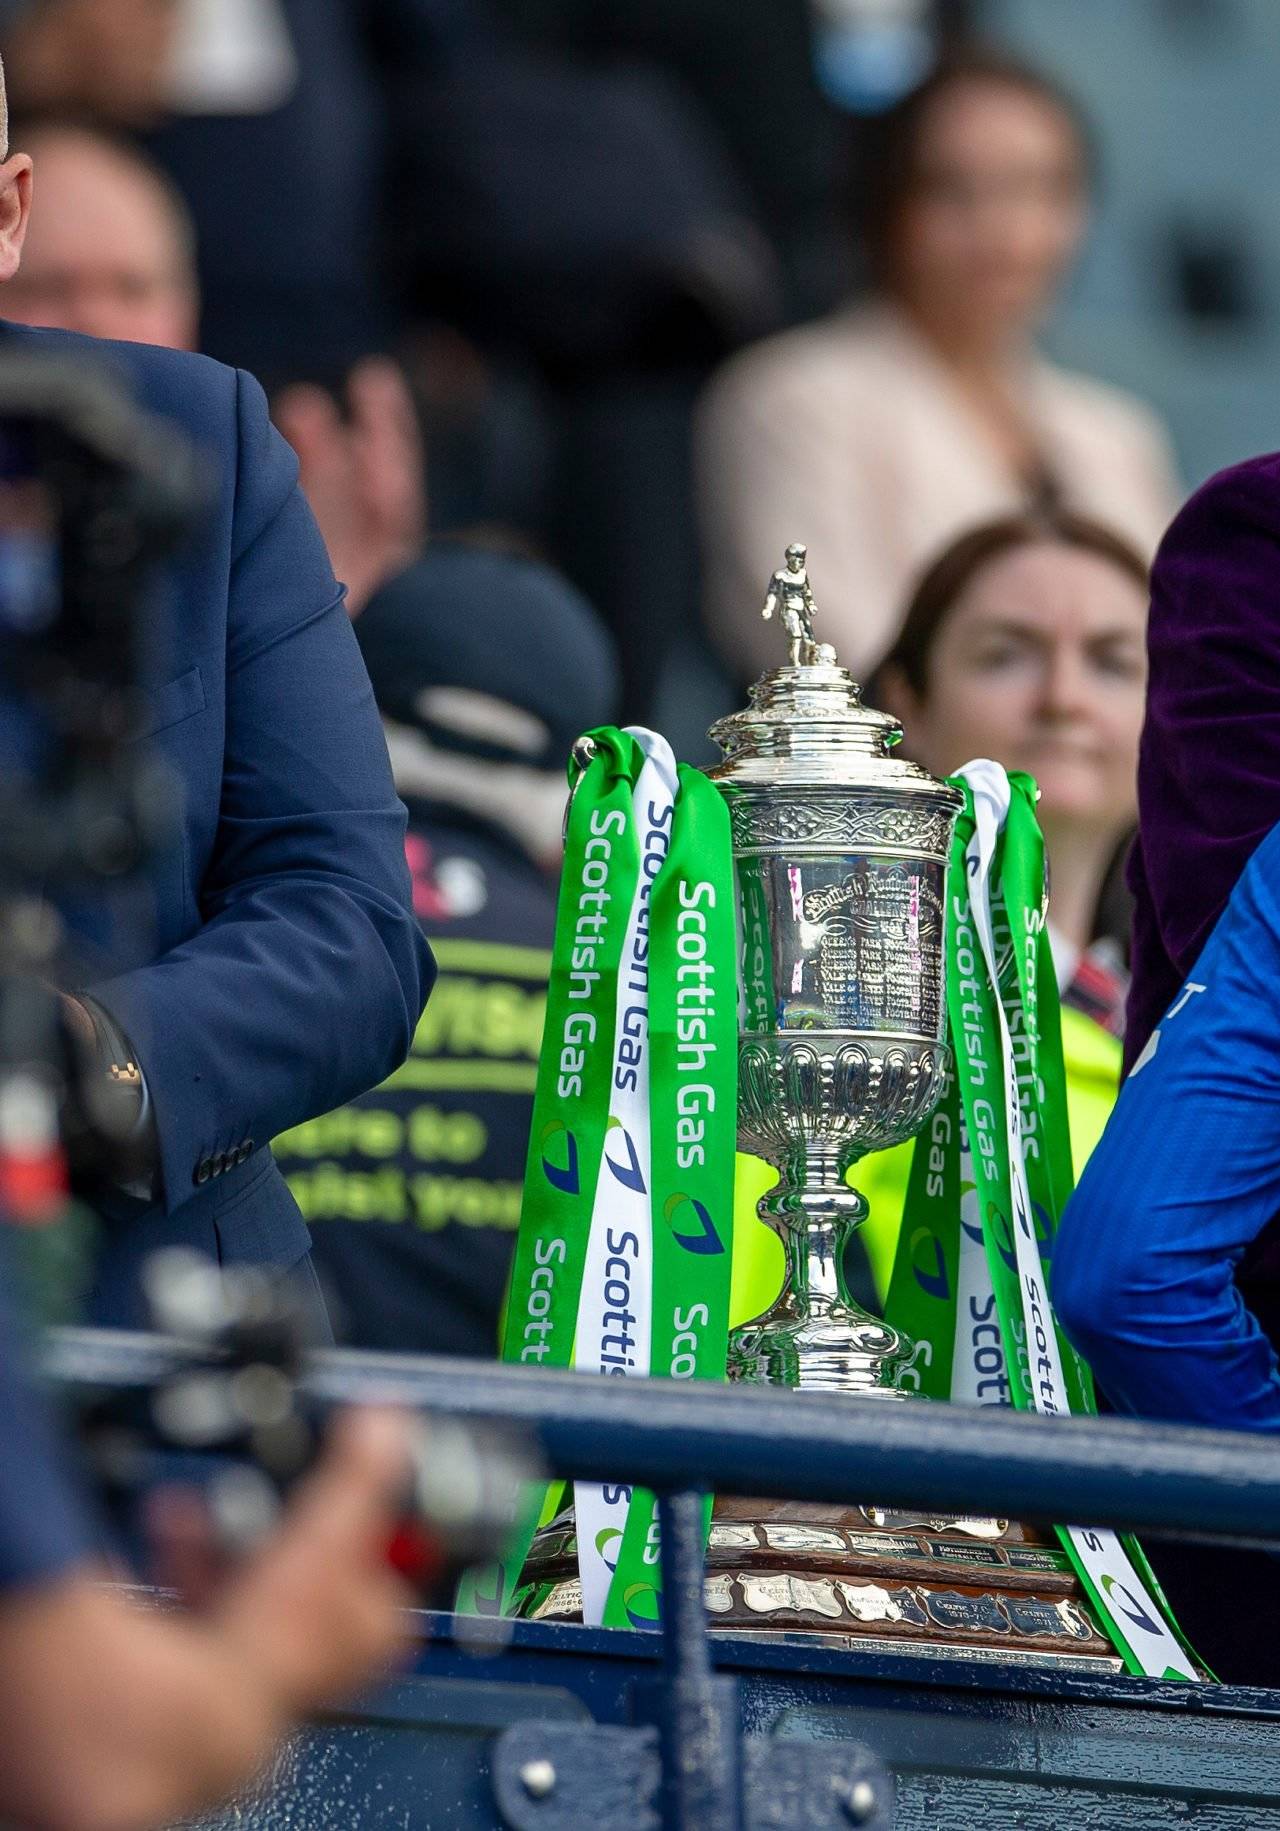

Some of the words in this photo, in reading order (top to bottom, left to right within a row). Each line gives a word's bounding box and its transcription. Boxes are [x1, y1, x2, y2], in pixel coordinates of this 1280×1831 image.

[568, 809, 626, 999] Scottish
[676, 880, 717, 1070] Scottish
[557, 1012, 597, 1098] Gas
[614, 1006, 648, 1092] Gas
[953, 896, 988, 1086] Scottish
[973, 1100, 999, 1182] Gas
[677, 1084, 715, 1168] Gas
[926, 1112, 951, 1197] Gas
[521, 1238, 566, 1364] Scott
[1025, 1274, 1058, 1417] Scotti
